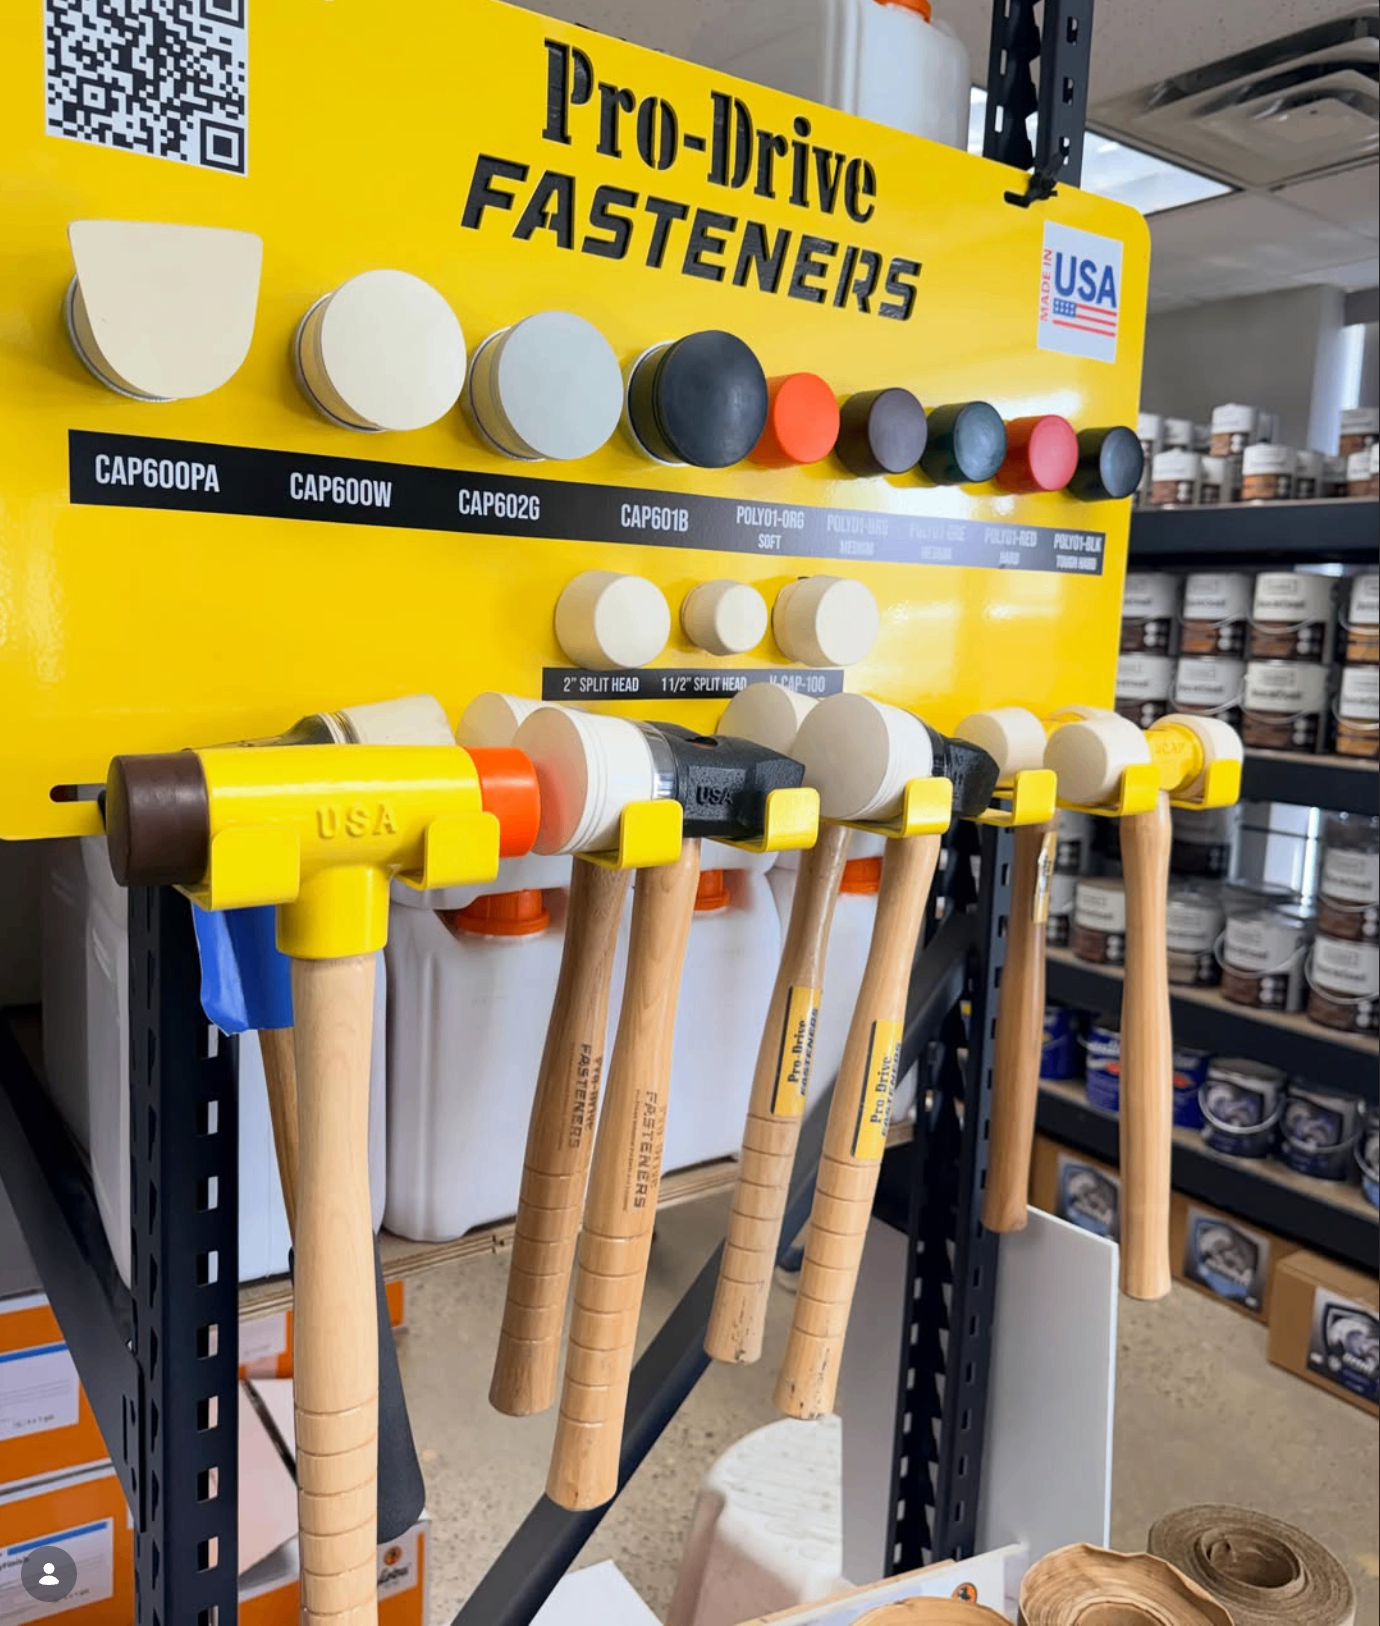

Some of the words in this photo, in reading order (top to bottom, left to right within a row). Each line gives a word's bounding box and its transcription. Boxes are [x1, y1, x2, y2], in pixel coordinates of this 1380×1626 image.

[542, 37, 877, 223] Pro-Drive
[460, 153, 922, 322] FASTENERS
[1043, 248, 1053, 267] IN
[1040, 272, 1051, 322] MADE
[1055, 252, 1117, 309] USA
[94, 453, 220, 494] CAP600PA
[289, 472, 392, 508] CAP600W
[458, 489, 541, 521] CAP602G
[620, 503, 689, 532] CAP601B
[736, 505, 805, 529] POLY01-ORG
[758, 533, 782, 550] SOFT
[563, 677, 577, 692] 2"
[579, 676, 610, 693] SPLIT
[611, 676, 639, 693] HEAD
[693, 676, 721, 692] SPLIT
[722, 676, 748, 692] HEAD
[769, 675, 826, 693] VCAP-100
[695, 785, 734, 806] USA
[315, 801, 398, 840] USA
[787, 1019, 807, 1083] Pro-Drive
[568, 1043, 592, 1149] FASTENERS
[870, 1056, 891, 1124] ProDrive
[633, 1090, 658, 1209] FASTENERS
